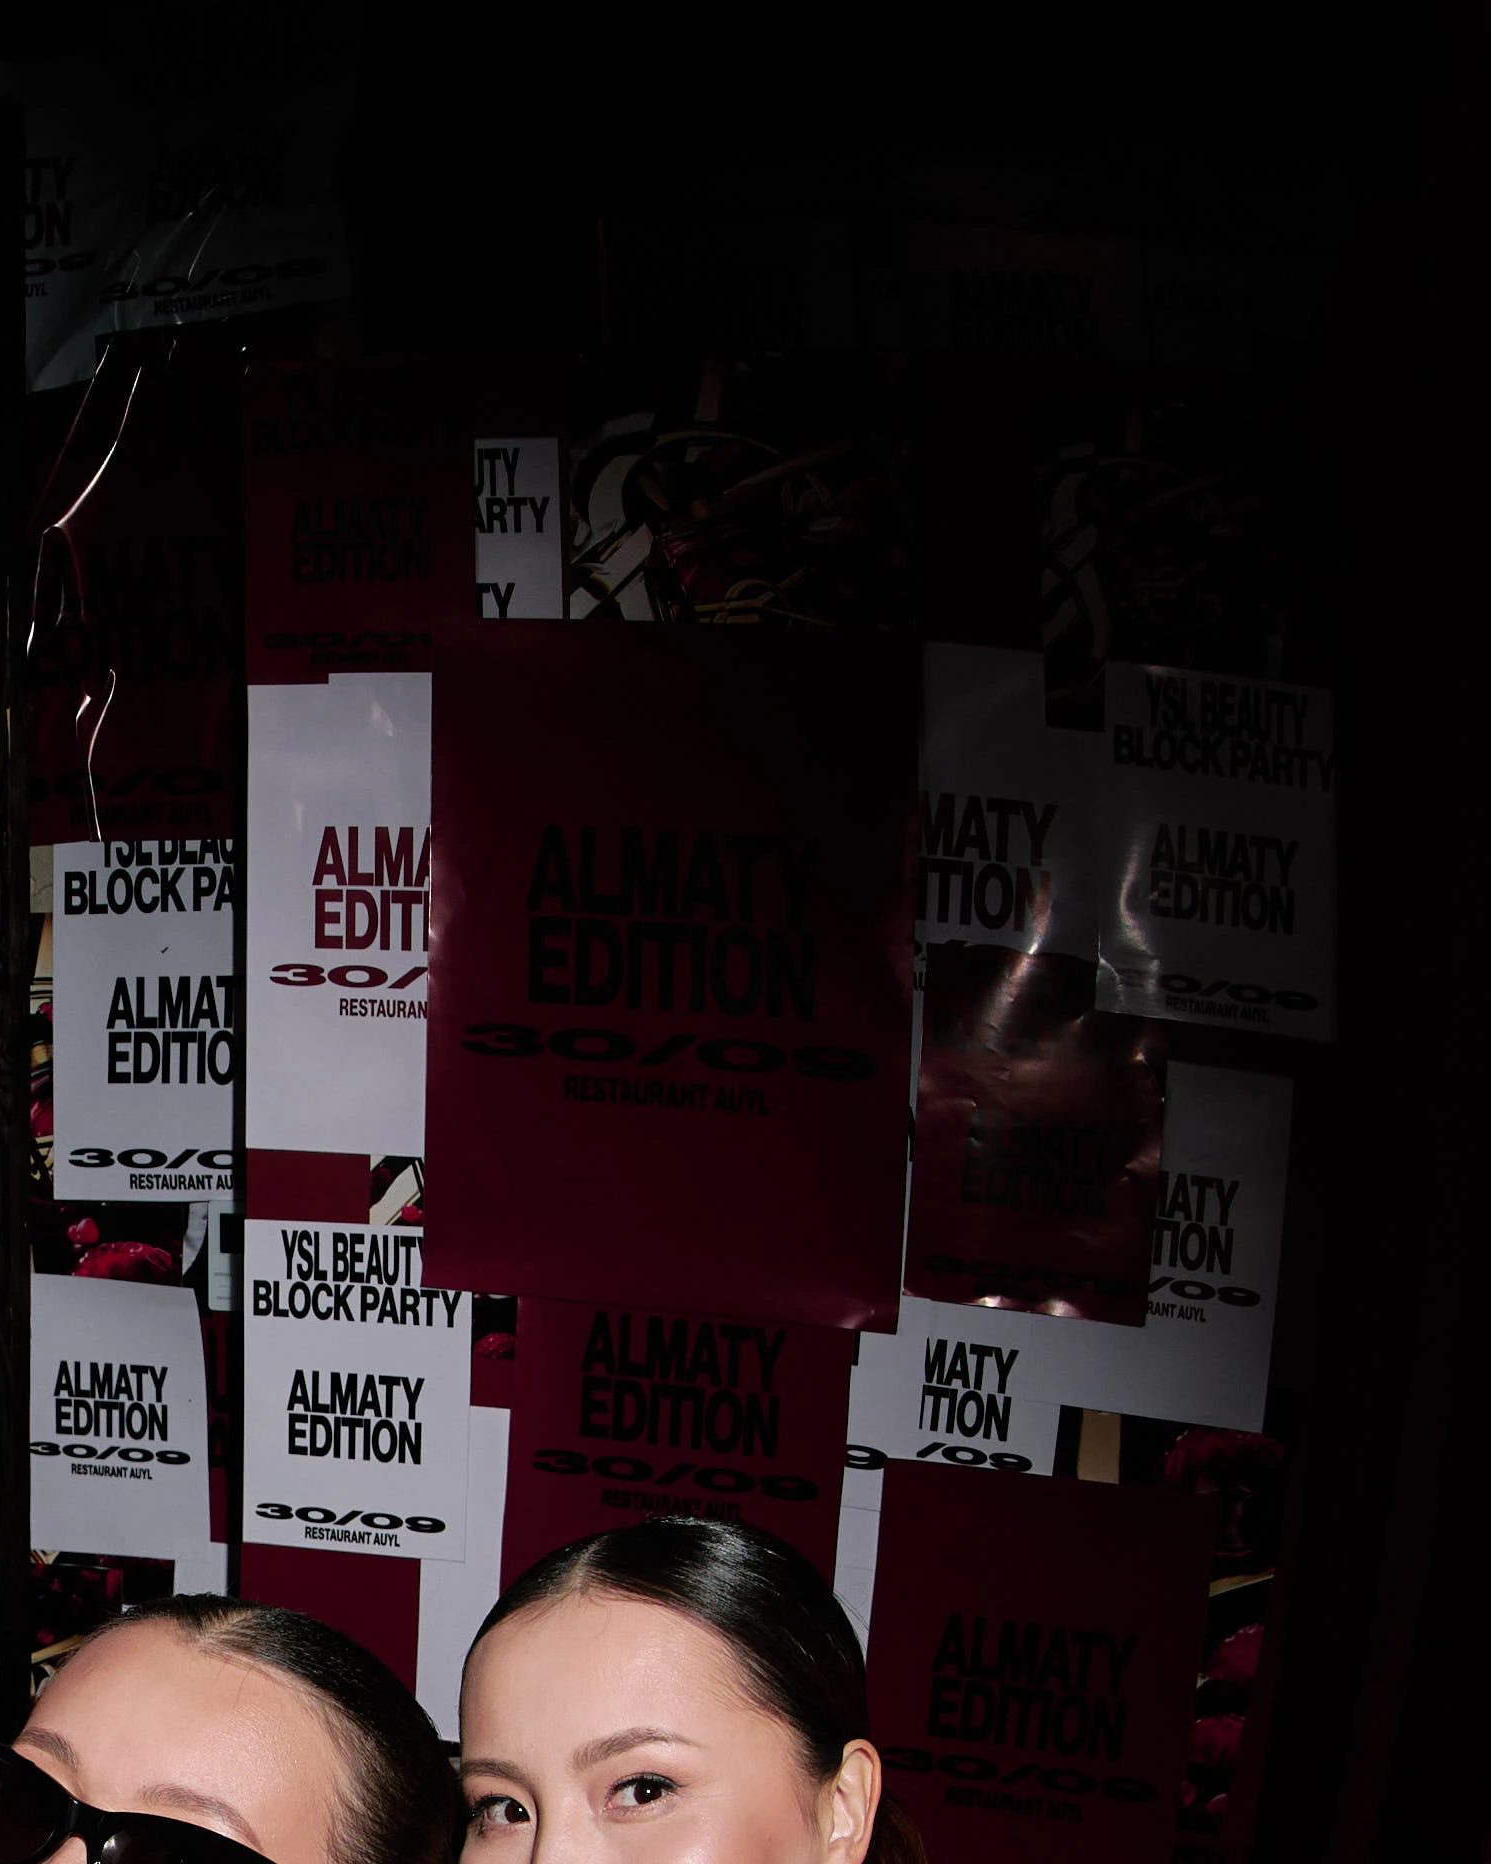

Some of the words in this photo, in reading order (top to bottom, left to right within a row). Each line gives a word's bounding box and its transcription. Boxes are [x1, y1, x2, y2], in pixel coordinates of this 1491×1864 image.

[1146, 675, 1194, 733] YSL
[1202, 681, 1308, 749] BEAUTY
[1114, 724, 1224, 778] BLOCK
[1230, 739, 1336, 792] PARTY
[527, 824, 821, 924] ALMATY
[1150, 822, 1299, 886] ALMATY
[65, 867, 186, 915] BLOCK
[1150, 869, 1295, 935] EDITION
[528, 917, 816, 1022] EDITION
[1123, 968, 1318, 1010] 0/09
[463, 1023, 877, 1081] 30/09
[130, 1174, 213, 1190] RESTAURANT
[281, 1230, 331, 1282] YSL
[253, 1279, 354, 1322] BLOCK
[360, 1285, 462, 1328] PARTY
[1178, 1304, 1206, 1322] AUYL
[580, 1311, 787, 1392] ALMATY
[54, 1361, 168, 1402] ALMATY
[288, 1370, 424, 1420] ALMATY
[55, 1398, 167, 1441] EDITION
[288, 1416, 422, 1465] EDITION
[580, 1375, 780, 1458] EDITION
[29, 1441, 190, 1465] 30/09
[71, 1464, 128, 1478] RESTAURANT
[130, 1467, 153, 1480] AUYL
[533, 1449, 819, 1501] 30/09
[255, 1503, 446, 1533] 30/09
[305, 1527, 371, 1545] RESTAURANT
[373, 1532, 400, 1547] AUYL
[932, 1612, 1138, 1696] ALMATY
[927, 1676, 1127, 1763] EDITION
